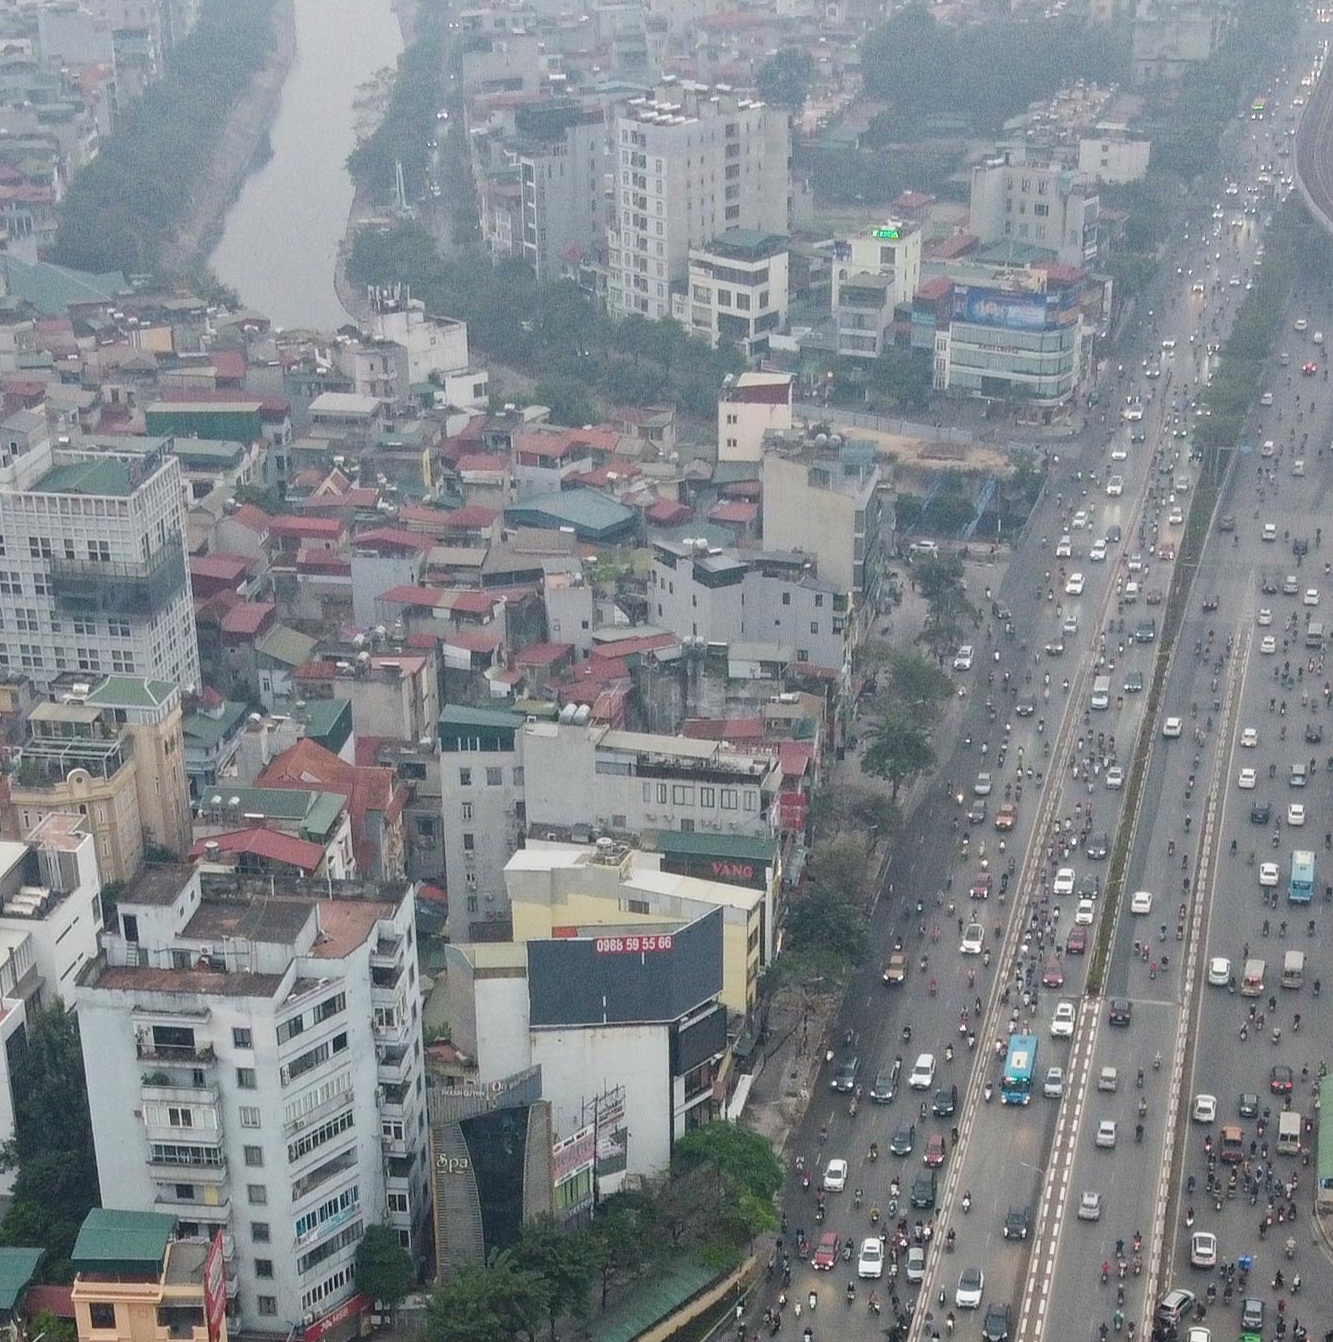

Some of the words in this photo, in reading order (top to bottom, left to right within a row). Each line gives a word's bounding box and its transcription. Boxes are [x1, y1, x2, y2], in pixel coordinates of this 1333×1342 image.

[625, 938, 640, 951] 59
[641, 937, 656, 950] 55
[657, 936, 672, 949] 66
[435, 1152, 468, 1174] Spa
